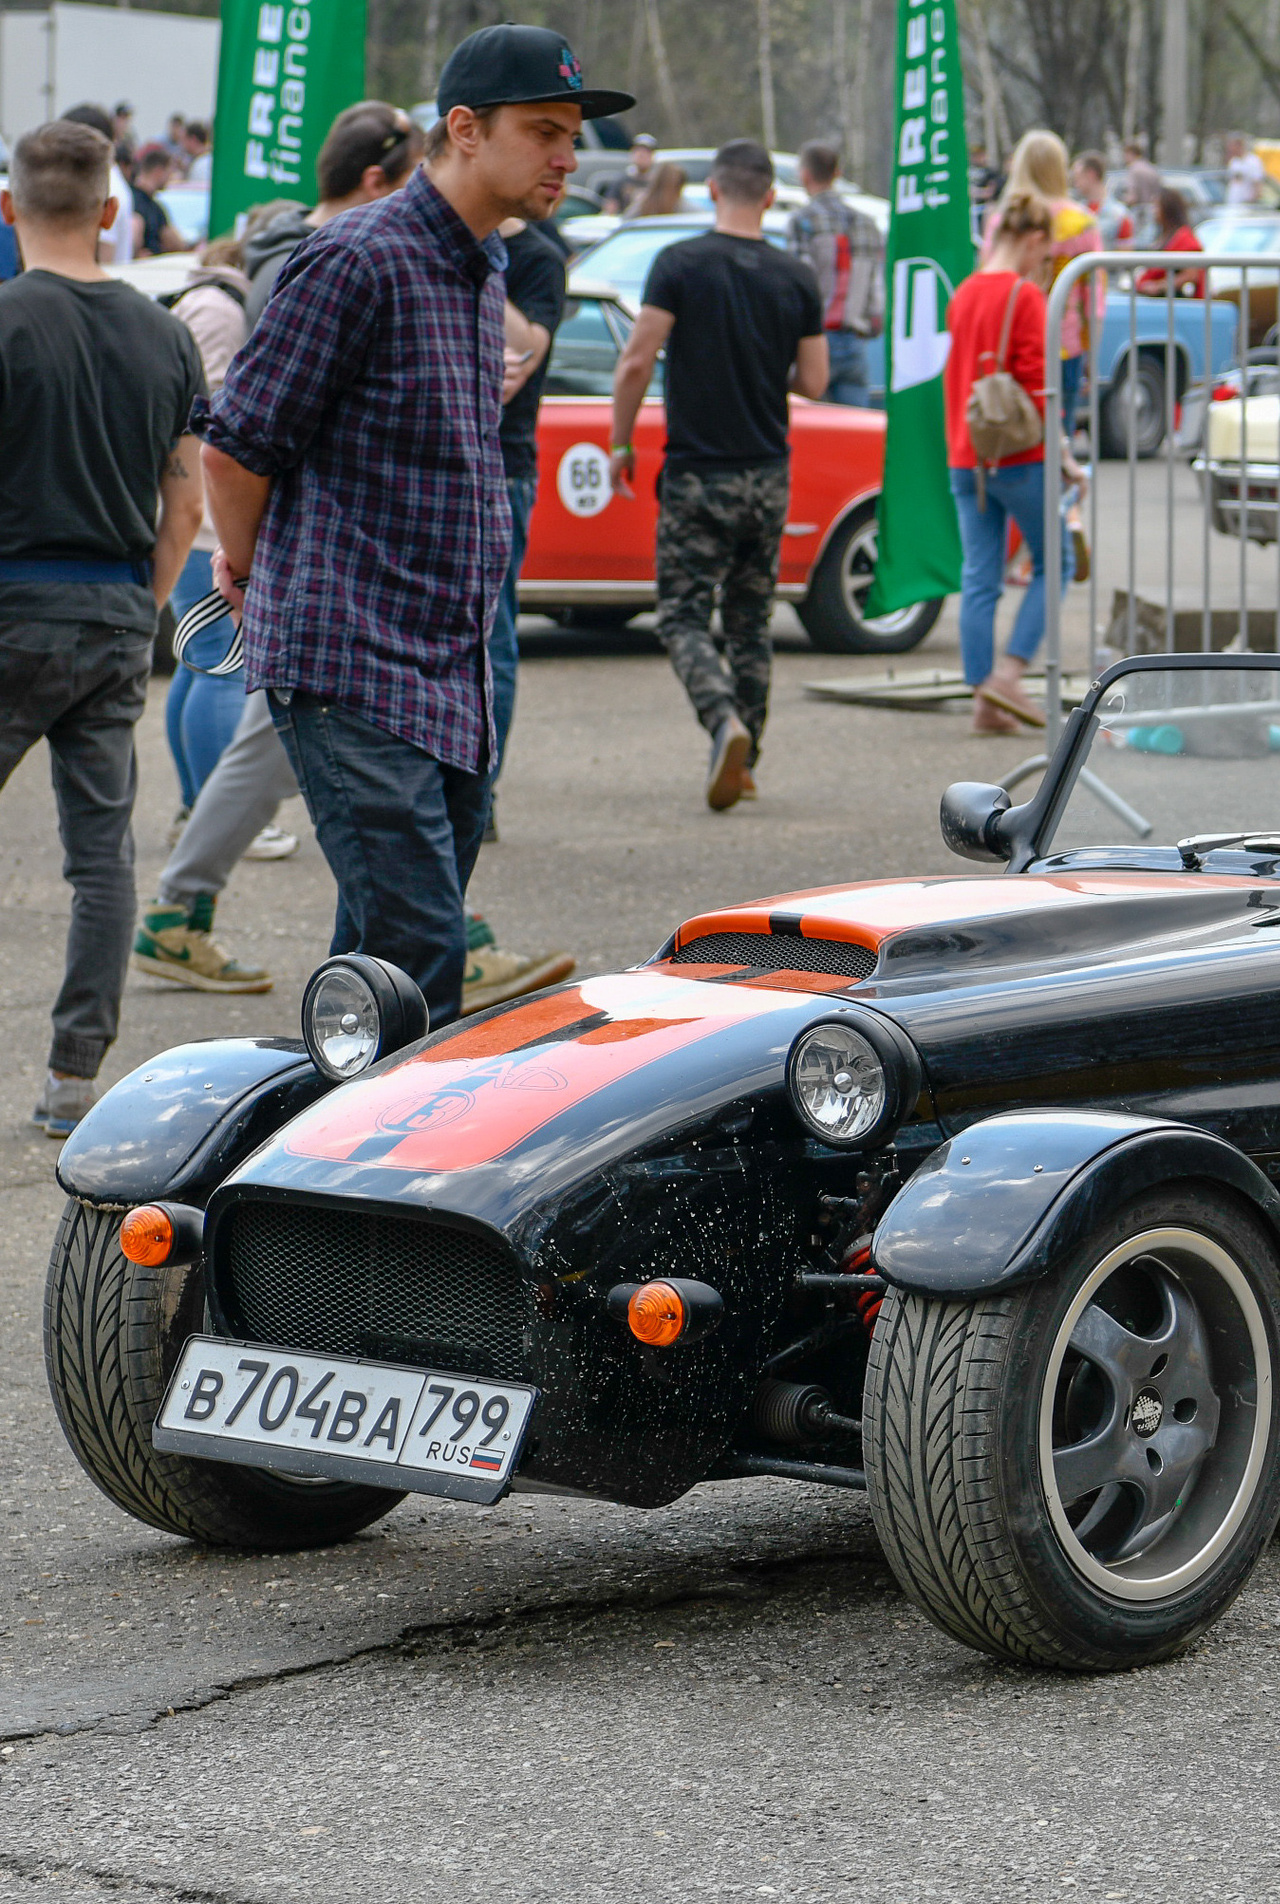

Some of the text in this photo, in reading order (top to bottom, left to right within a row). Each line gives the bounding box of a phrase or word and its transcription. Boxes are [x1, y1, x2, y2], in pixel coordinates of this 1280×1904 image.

[269, 0, 311, 184] financ
[896, 0, 927, 214] FREE
[925, 0, 950, 209] financ
[571, 459, 601, 490] 66
[419, 1384, 510, 1446] 799
[426, 1441, 471, 1465] RUS
